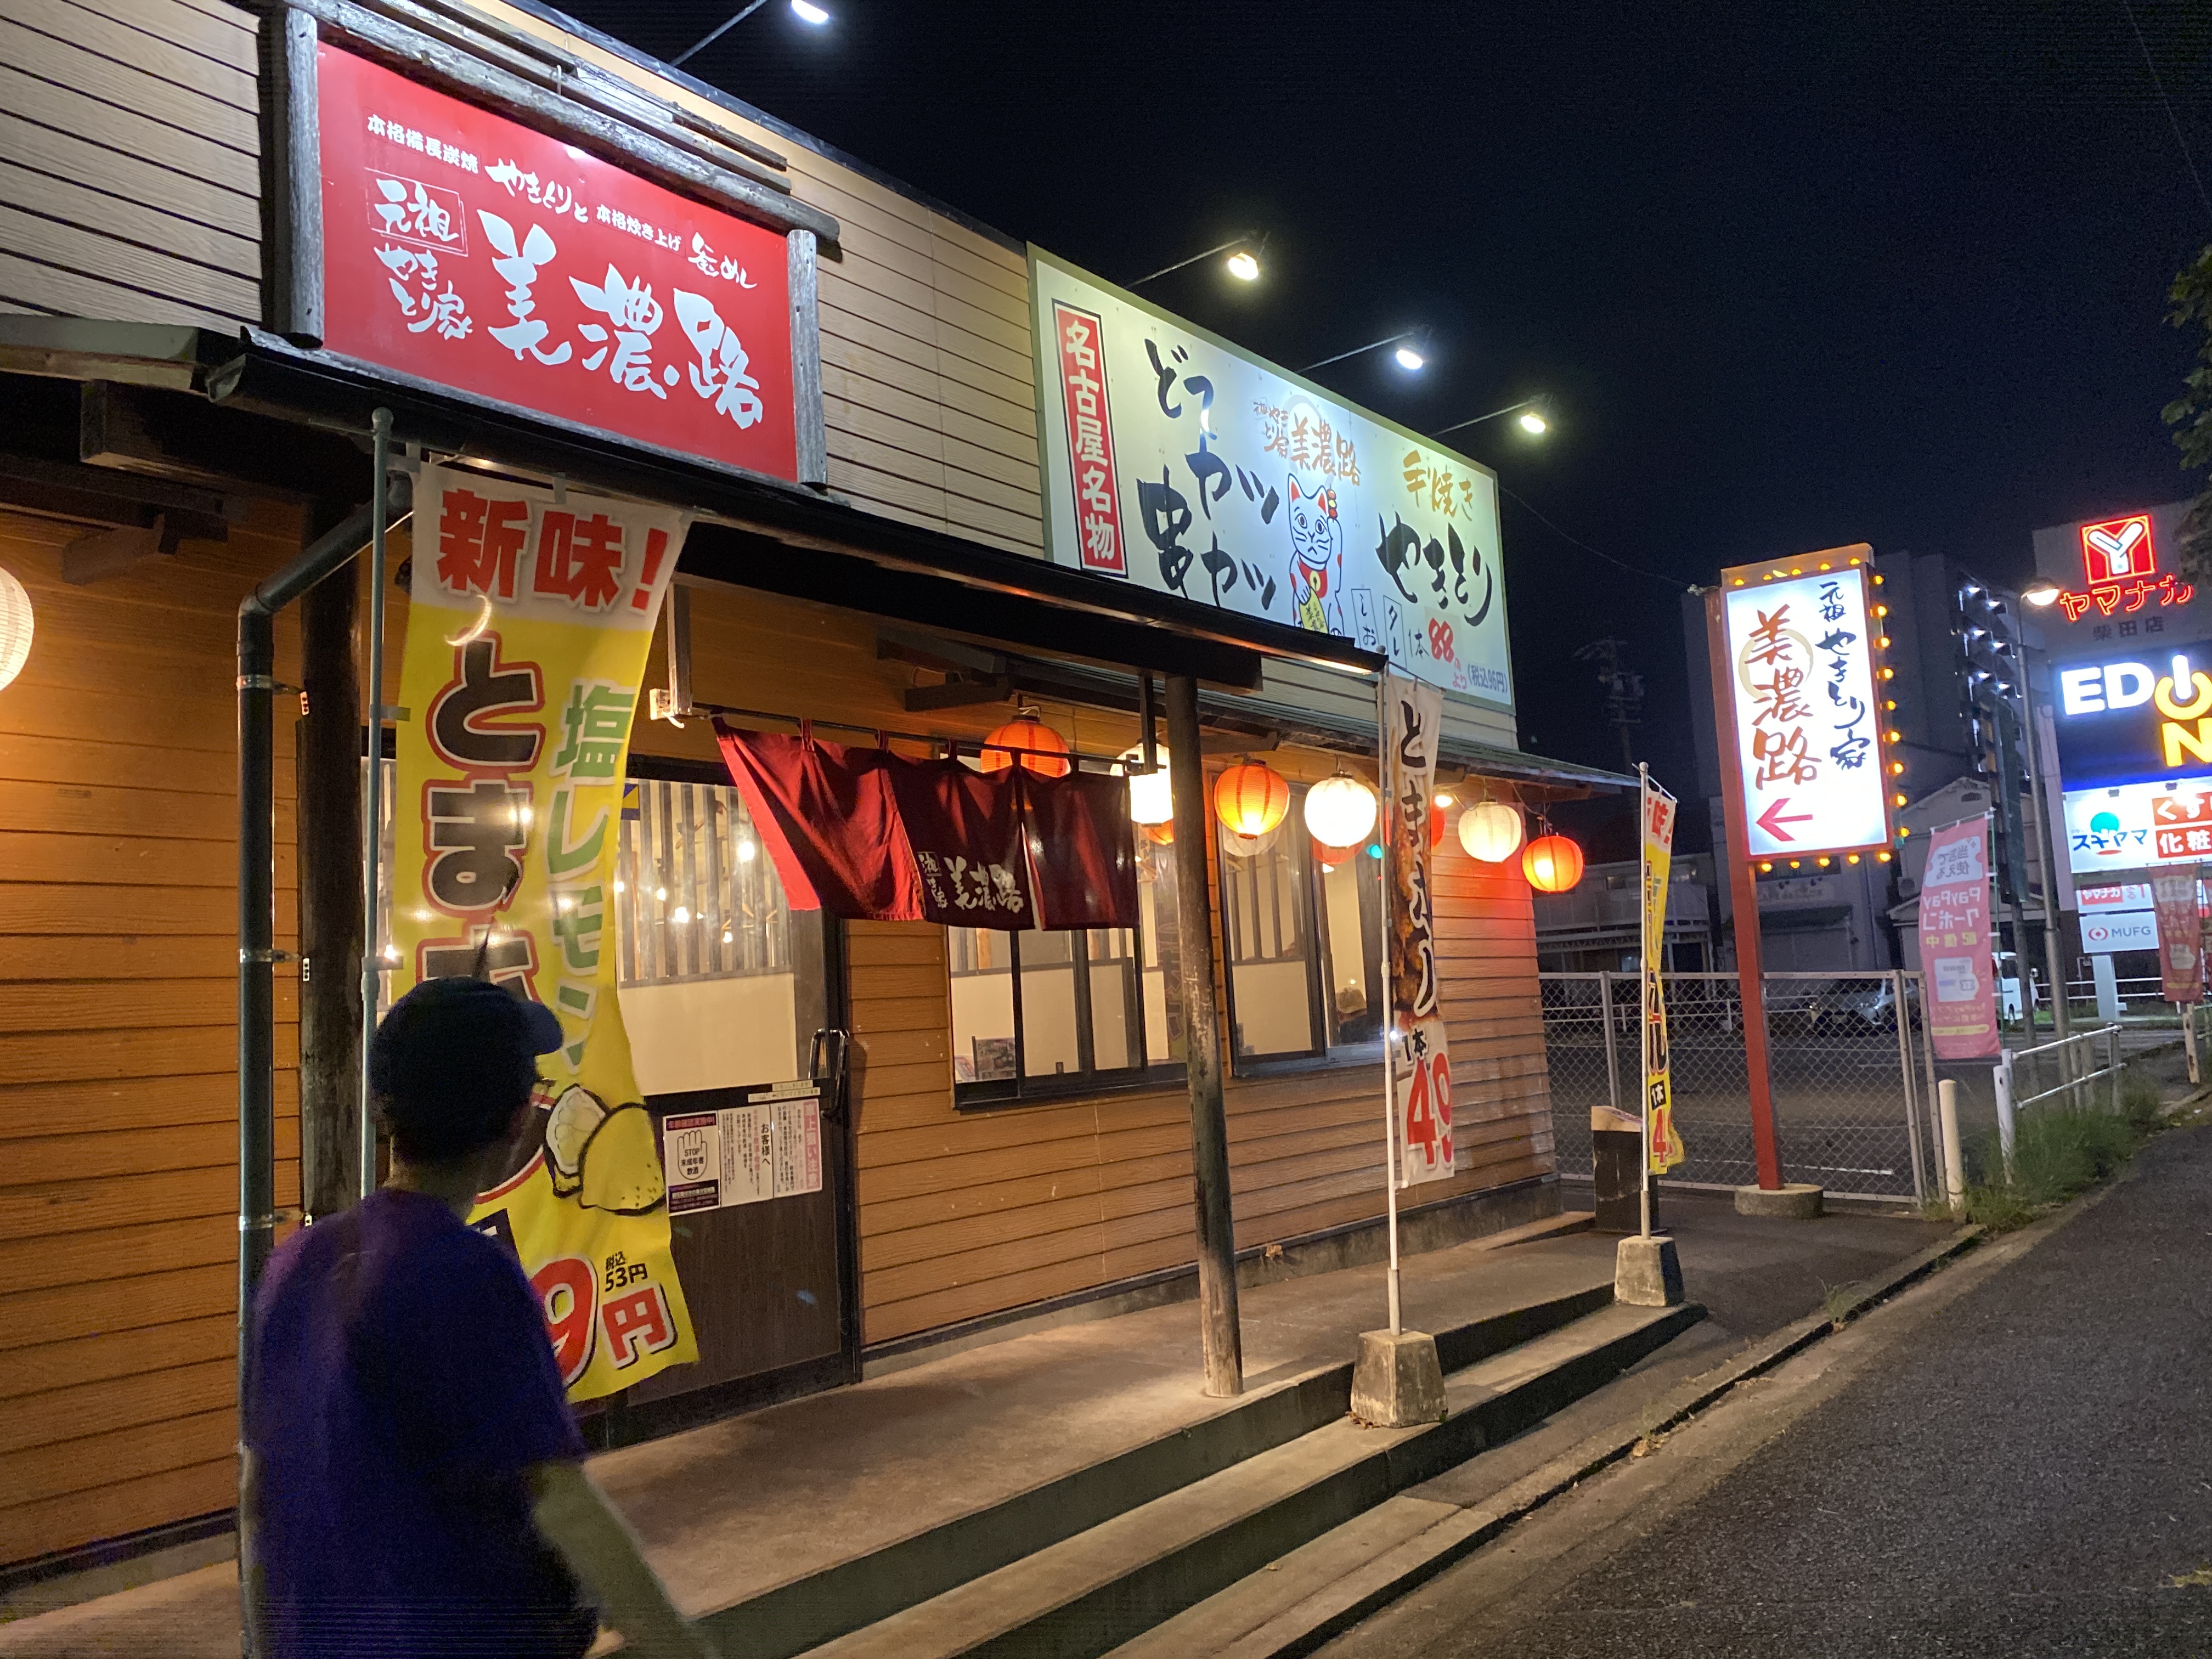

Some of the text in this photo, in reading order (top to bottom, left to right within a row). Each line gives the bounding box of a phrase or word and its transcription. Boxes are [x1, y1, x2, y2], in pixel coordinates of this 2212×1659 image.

[367, 114, 479, 174] 本格備長炭焼
[596, 204, 682, 252] 本格炊き上げ
[374, 178, 460, 242] 元祖
[476, 208, 763, 430] 美濃路
[1065, 319, 1116, 562] 名古屋名物
[1290, 411, 1361, 487] 美濃路
[1402, 449, 1474, 522] 手焼き
[1375, 510, 1492, 627] やきとり
[2059, 573, 2194, 622] ヤマナカ
[1359, 593, 1376, 646] しお
[1468, 663, 1508, 694] (税込96円)
[1743, 603, 1822, 791] 美濃路
[2111, 926, 2151, 938] MUFG
[684, 1148, 700, 1157] STOP
[761, 1123, 771, 1165] お客様へ
[605, 1251, 628, 1272] 税込
[605, 1262, 648, 1293] 53円
[530, 1257, 669, 1379] 9円
